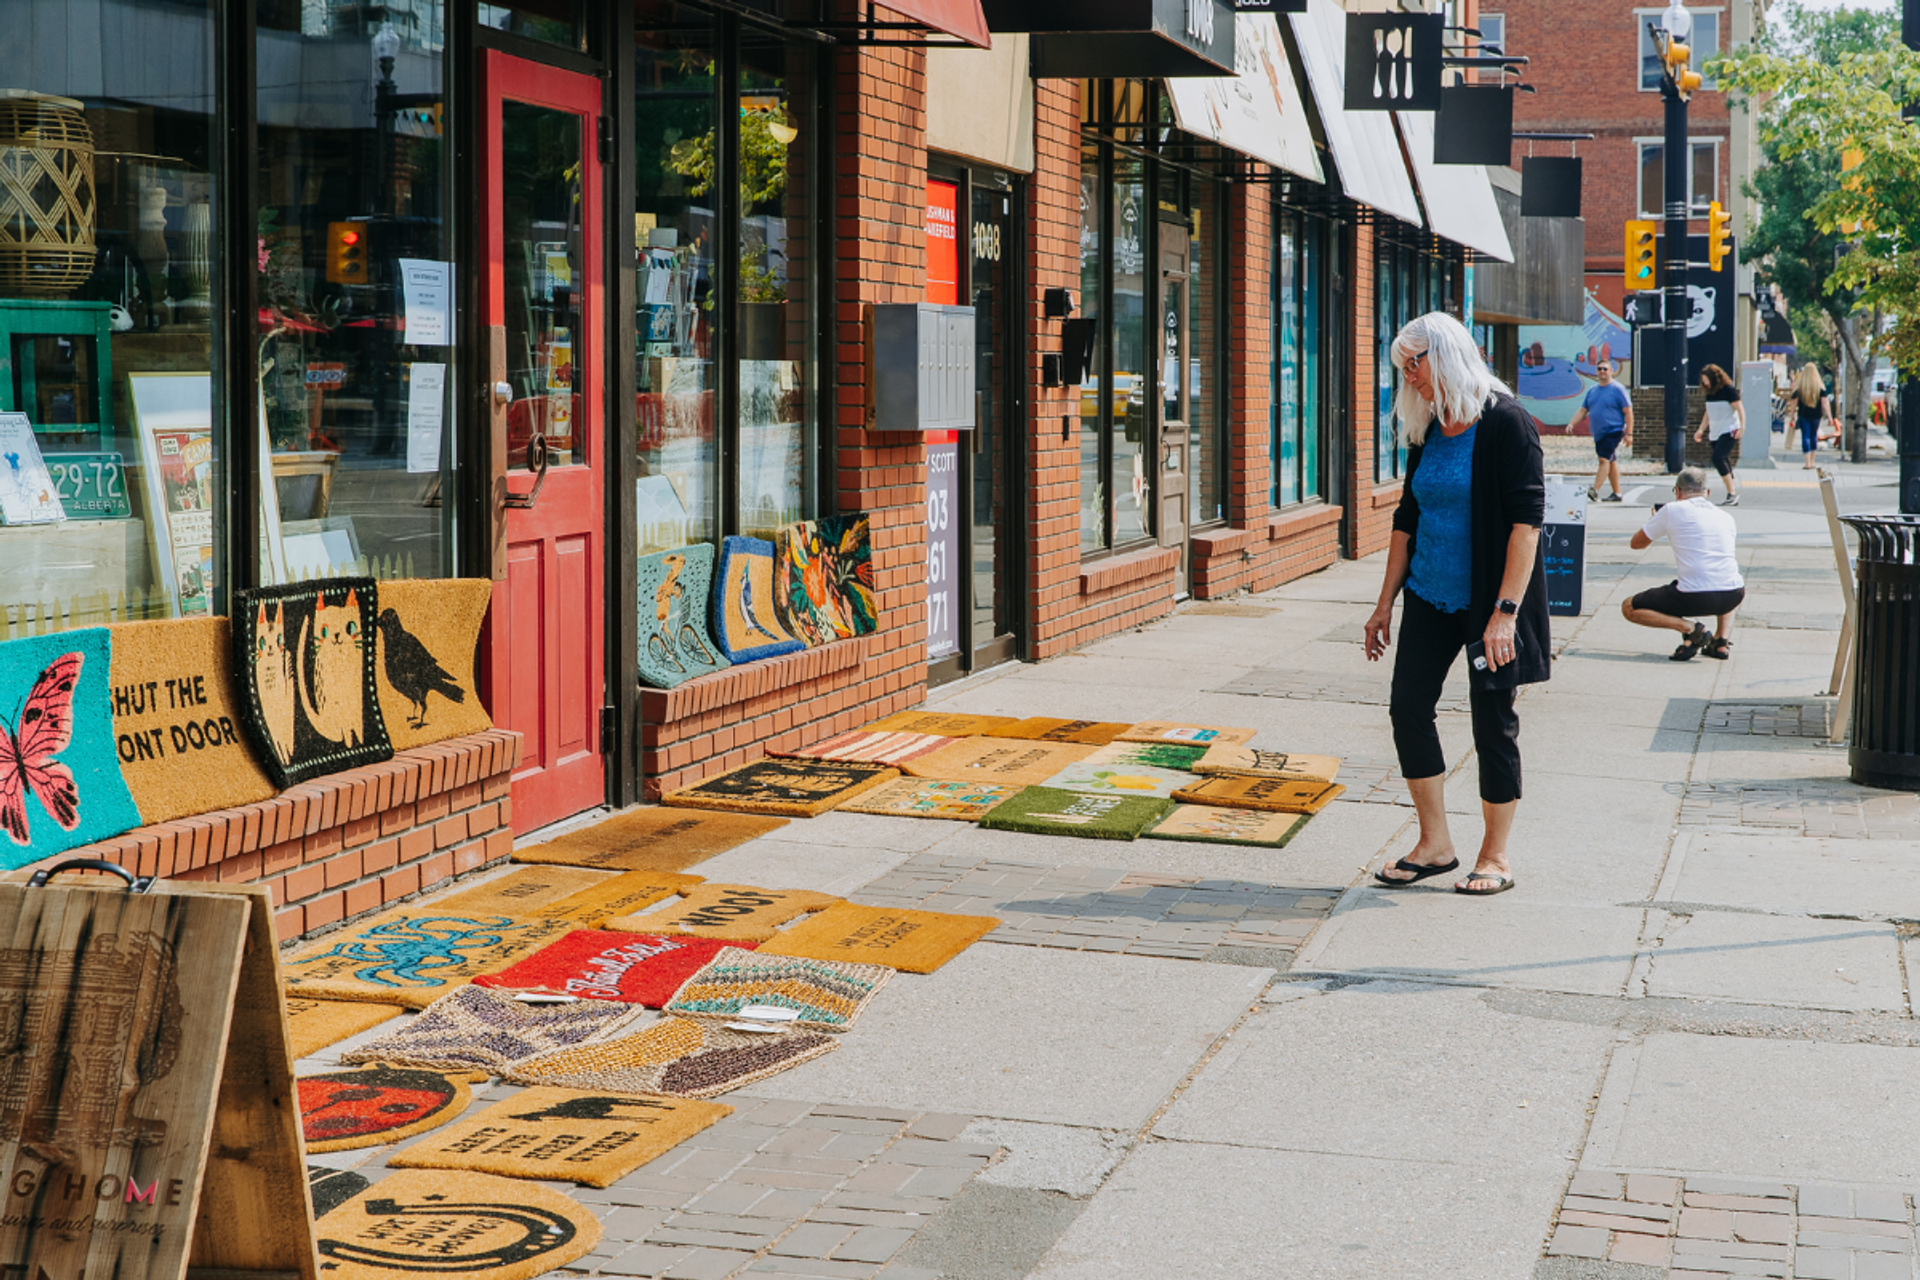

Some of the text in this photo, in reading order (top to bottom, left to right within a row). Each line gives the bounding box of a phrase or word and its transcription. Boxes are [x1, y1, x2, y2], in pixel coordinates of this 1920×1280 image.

[931, 453, 955, 472] SCOTT
[74, 500, 126, 512] ALBERTA
[164, 675, 208, 709] THE
[116, 716, 239, 765] ONT DOOR
[62, 1172, 184, 1207] HOME
[391, 1219, 458, 1247] YOUR
